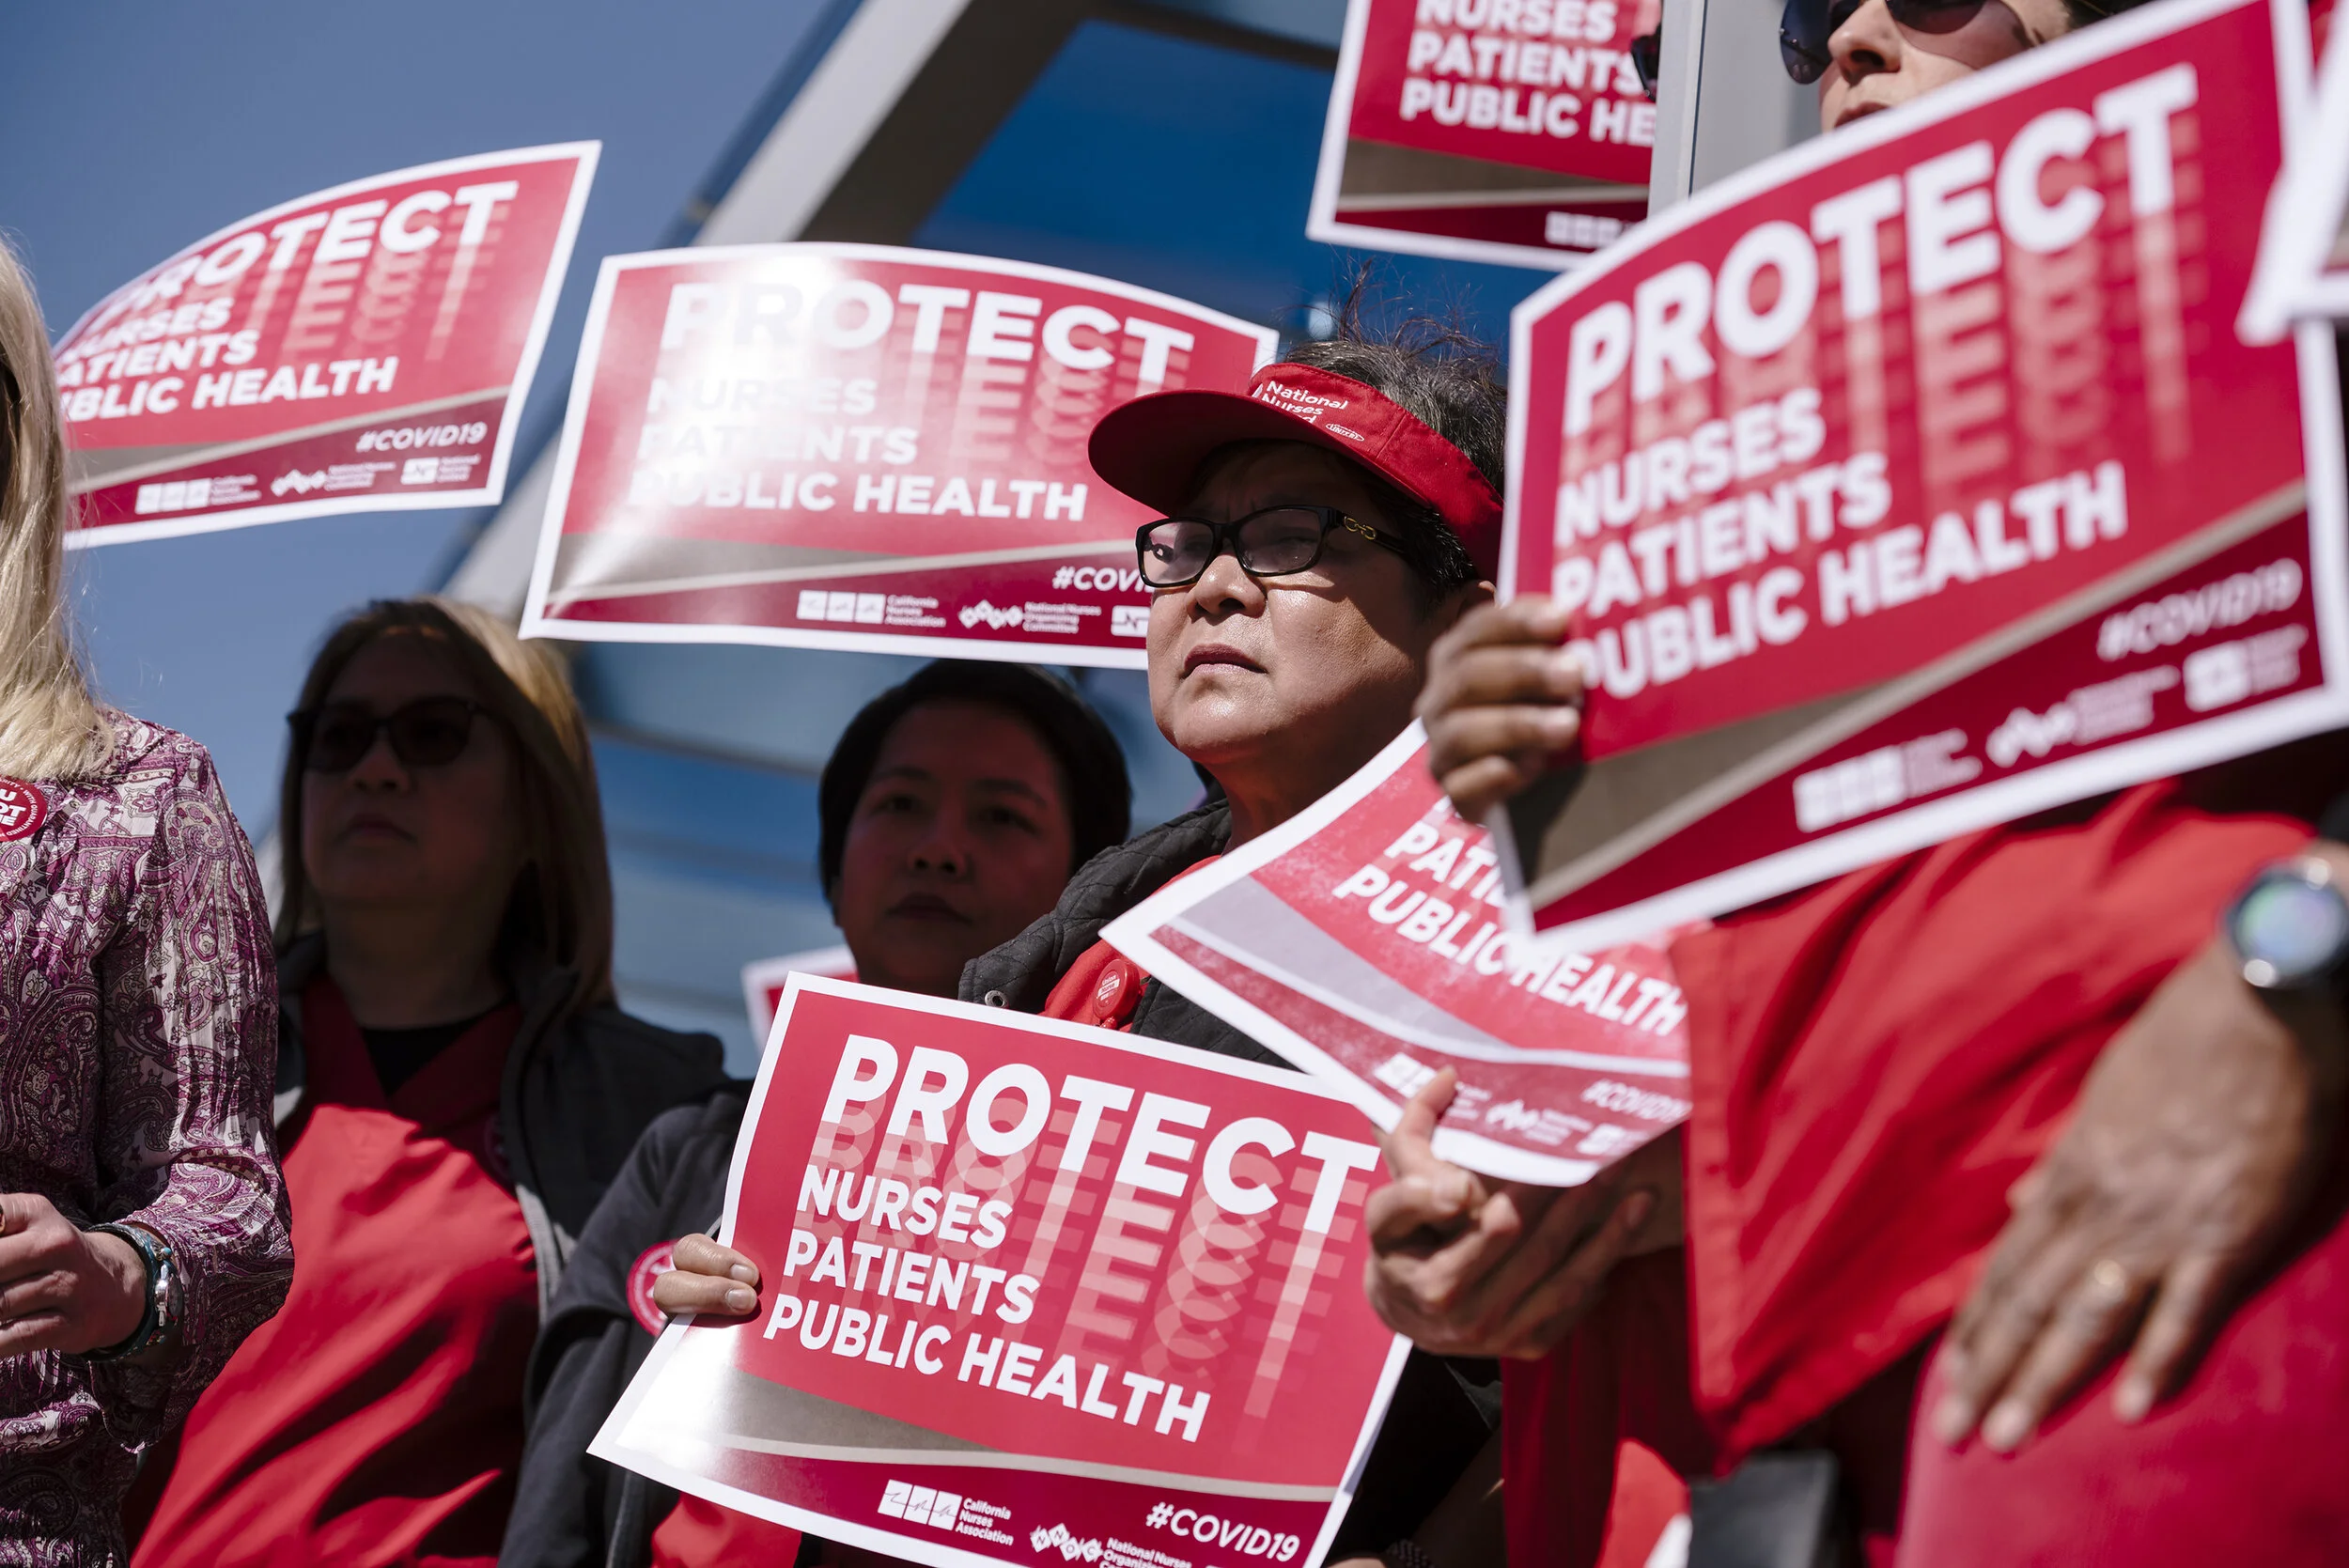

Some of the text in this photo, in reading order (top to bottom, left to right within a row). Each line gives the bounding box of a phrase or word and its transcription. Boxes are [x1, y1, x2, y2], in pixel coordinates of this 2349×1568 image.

[1416, 0, 1616, 43] NURSES
[1398, 78, 1582, 139] PUBLIC
[1564, 63, 2198, 437] PROTECT
[56, 329, 259, 387] ATIENTS
[661, 279, 1195, 389] PROTECT
[60, 359, 397, 423] BLIC HEALTH
[647, 378, 878, 415] NURSES
[1267, 380, 1348, 410] National
[356, 421, 488, 454] #COVID19
[636, 423, 920, 466] PATIENTS
[628, 472, 1088, 521] PUBLIC HEALTH
[1553, 388, 1826, 549] NURSES
[1549, 452, 1892, 620] PATIENTS
[1818, 458, 2128, 626] HEALTH
[822, 1033, 1381, 1233] PROTECT
[795, 1164, 1013, 1250] NURSES
[783, 1229, 1041, 1325] PATIENTS
[765, 1294, 1212, 1443] PUBLIC HEALTH
[955, 1523, 1014, 1546] Association
[959, 1509, 994, 1529] Nurses
[963, 1498, 1012, 1520] California
[1145, 1501, 1300, 1562] #COVID19
[1106, 1536, 1156, 1560] National
